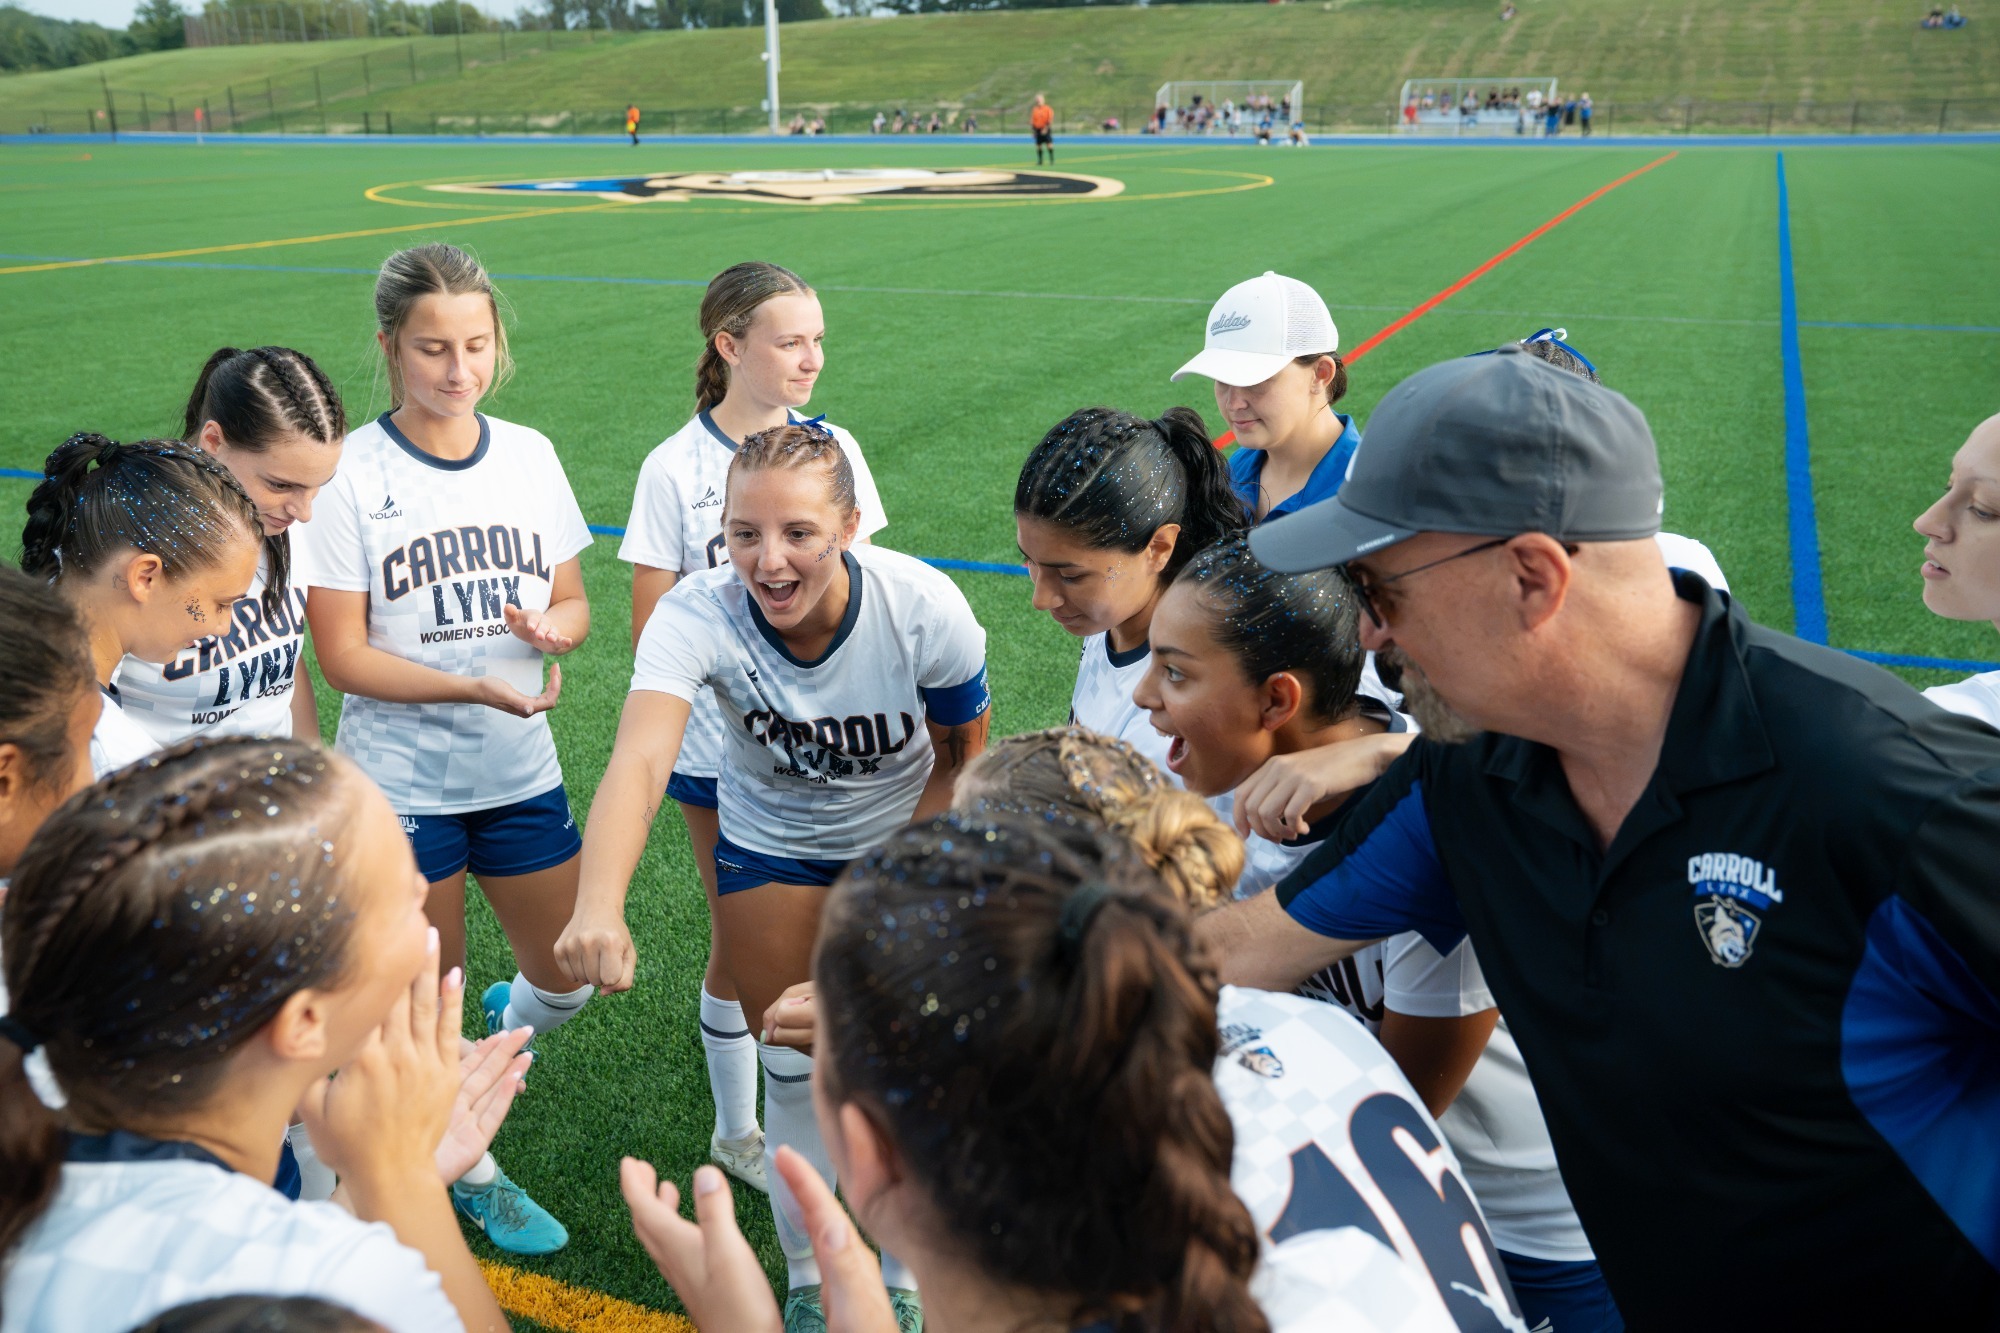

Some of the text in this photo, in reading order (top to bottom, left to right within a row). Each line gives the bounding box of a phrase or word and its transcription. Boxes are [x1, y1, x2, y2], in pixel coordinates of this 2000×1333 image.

[368, 509, 403, 520] VOLAI
[691, 498, 723, 510] VOLAI
[383, 524, 550, 602] CARROLL
[432, 575, 522, 626] LYNX
[420, 623, 511, 644] WOMEN'S SOC
[213, 638, 299, 707] LYNX
[1687, 852, 1783, 904] CARROLL
[1706, 881, 1751, 900] LYNX
